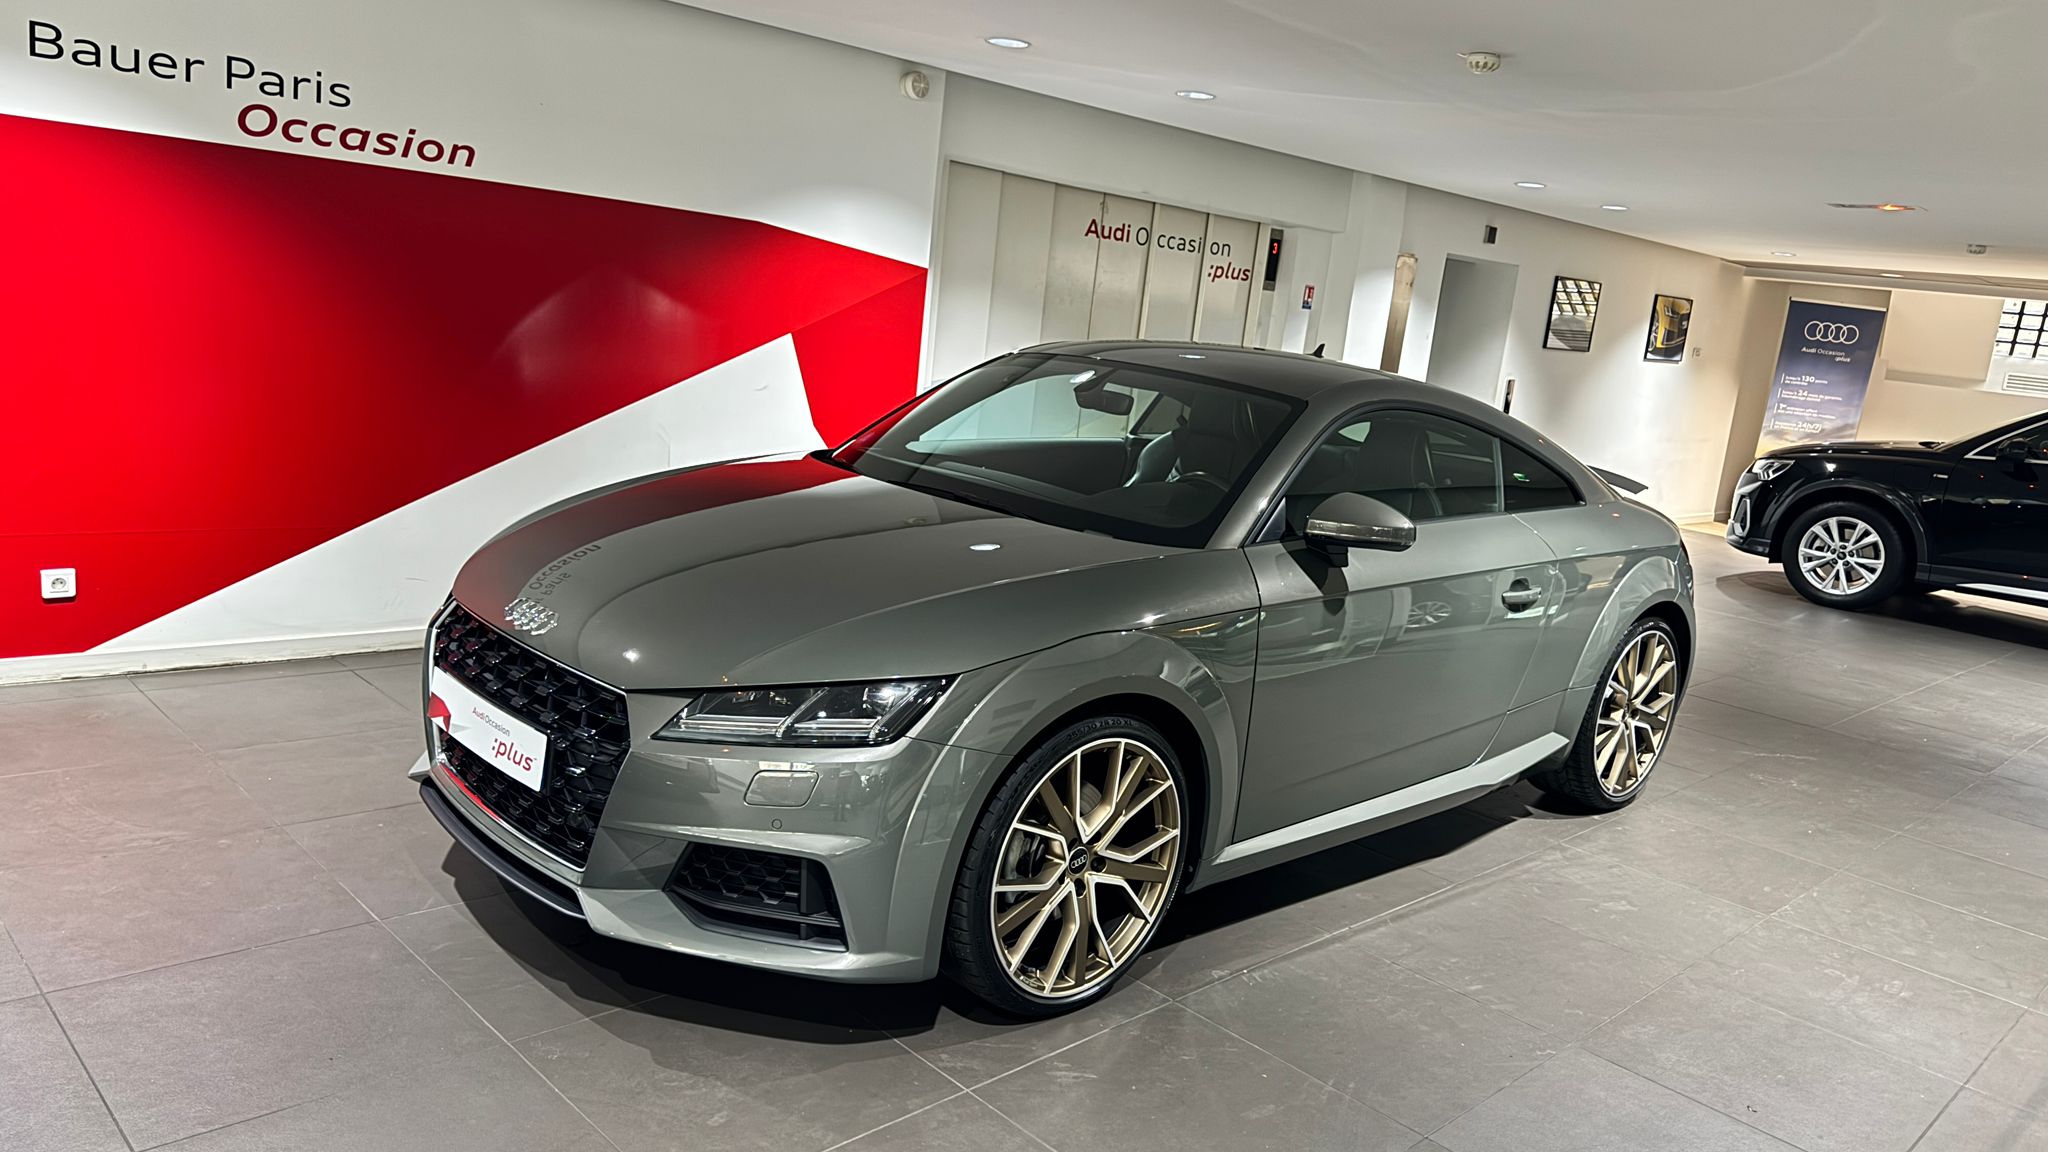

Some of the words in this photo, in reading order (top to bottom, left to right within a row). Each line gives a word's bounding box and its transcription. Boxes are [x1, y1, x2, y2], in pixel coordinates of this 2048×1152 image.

[28, 20, 205, 82] Bauer
[225, 55, 352, 108] Paris
[237, 103, 476, 168] Occasion
[1084, 218, 1131, 243] Audi
[1135, 226, 1231, 257] Occasion
[1207, 261, 1251, 283] :plus
[1817, 349, 1845, 357] Occasion
[1801, 375, 1815, 383] 130
[472, 706, 486, 721] Audi
[485, 714, 511, 737] Occasion
[491, 737, 534, 772] :plus
